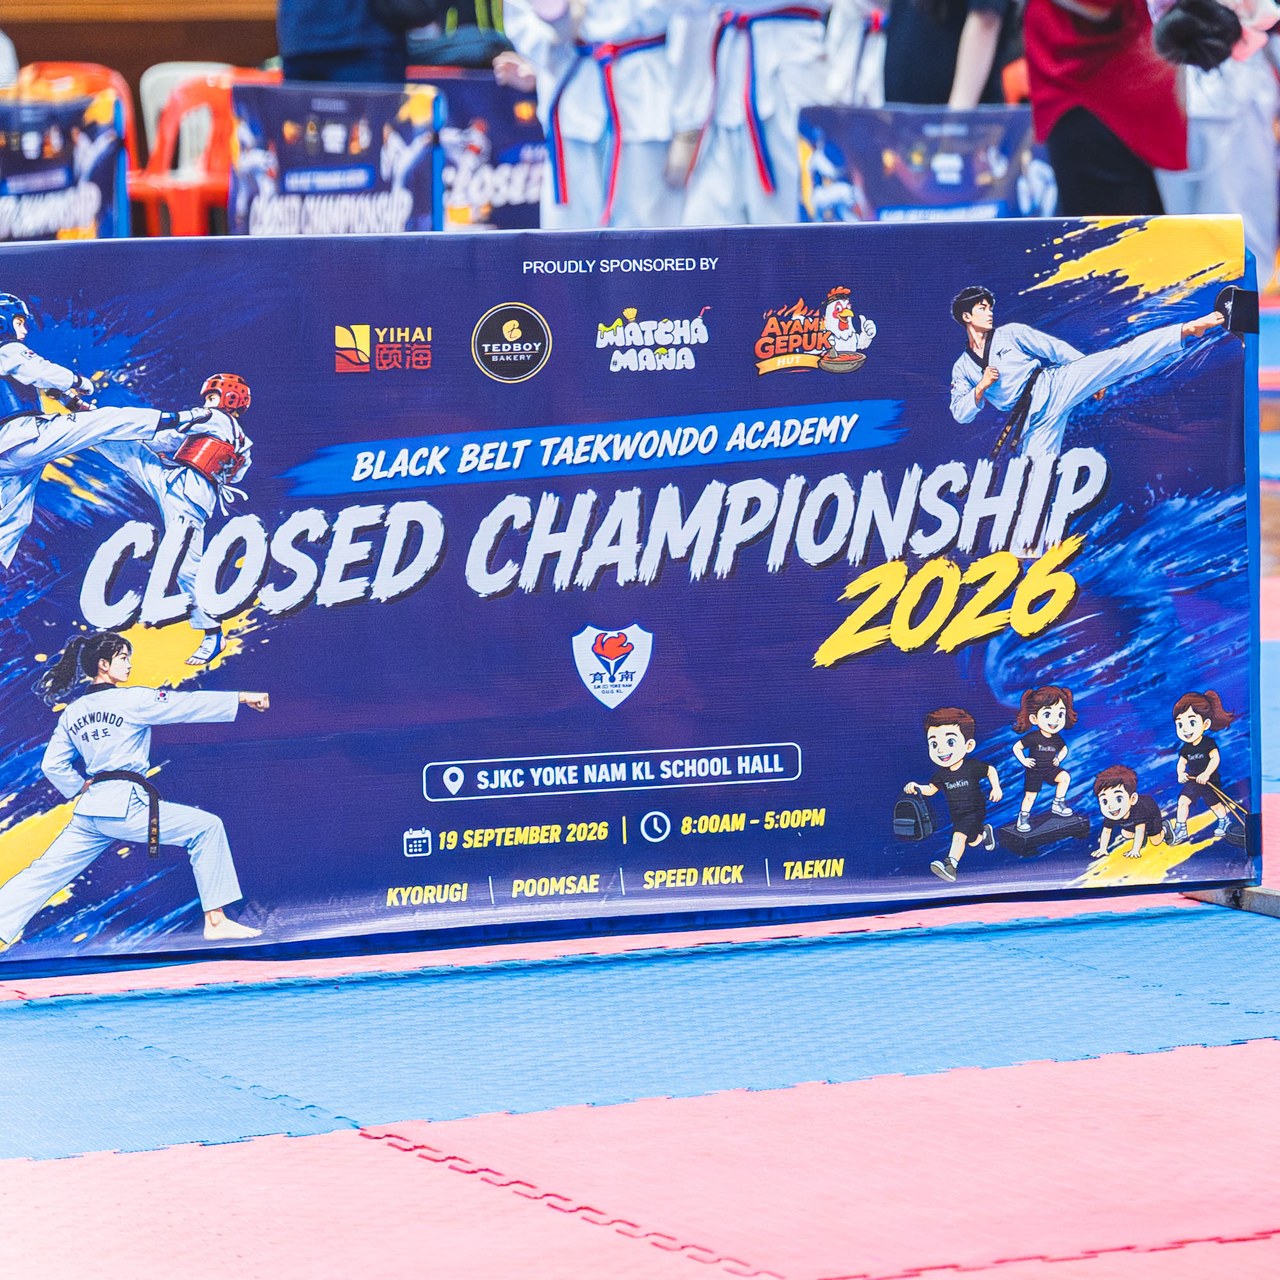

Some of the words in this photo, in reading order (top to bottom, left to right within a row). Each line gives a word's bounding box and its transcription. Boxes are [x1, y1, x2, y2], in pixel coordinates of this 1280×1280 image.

[523, 260, 596, 274] PROUDLY
[600, 258, 696, 273] SPONSORED
[700, 257, 719, 270] BY
[375, 326, 432, 343] YIHAI
[761, 316, 820, 337] AYAM
[375, 343, 432, 370] 颐海
[482, 342, 542, 353] TEDBOY
[754, 331, 832, 359] GEPUK
[491, 354, 532, 362] BAKERY
[776, 356, 801, 366] HUT
[352, 446, 450, 482] BLACK
[457, 440, 532, 476] BELT
[540, 428, 718, 466] TAEKWONDO
[727, 413, 859, 453] ACADEMY
[79, 499, 445, 629] CLOSED
[467, 447, 1109, 598] CHAMPIONSHIP
[812, 534, 1083, 669] 2026
[69, 711, 124, 736] TAEKWONDO
[476, 768, 526, 791] SJKC
[531, 765, 579, 788] YOKE
[582, 763, 627, 785] NAM
[631, 762, 656, 782] KL
[660, 756, 732, 780] SCHOOL
[736, 752, 784, 776] HALL
[944, 779, 969, 791] TaeKin
[680, 812, 747, 835] 8:00AM
[764, 808, 826, 830] 5:00PM
[438, 831, 457, 851] 19
[462, 825, 562, 850] SEPTEMBER
[566, 821, 609, 843] 2026
[643, 866, 700, 890] SPEED
[702, 863, 744, 886] KICK
[783, 858, 845, 881] TAEKIN
[386, 883, 469, 907] KYORUGI
[511, 874, 600, 898] POOMSAE
